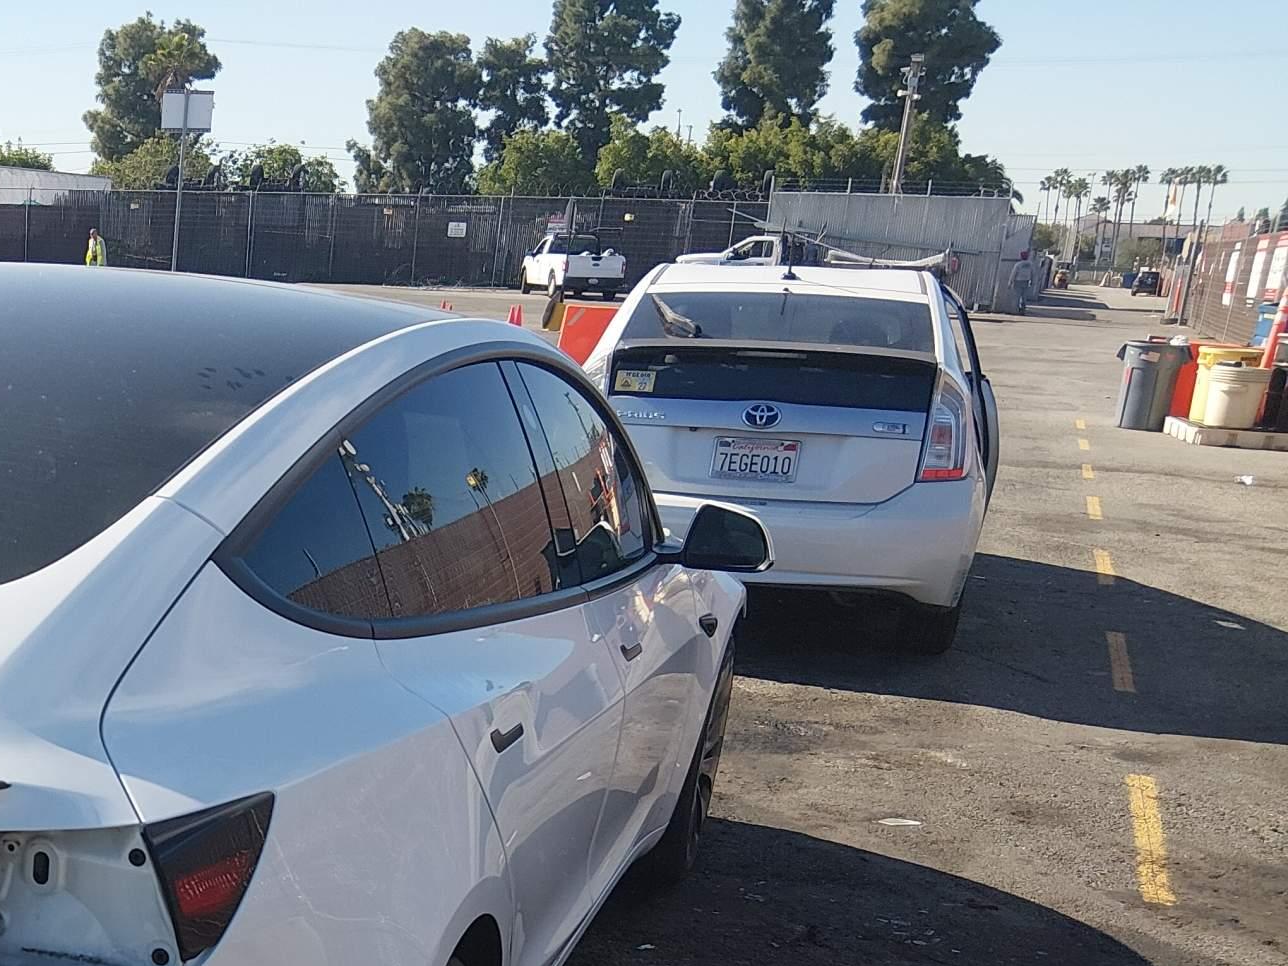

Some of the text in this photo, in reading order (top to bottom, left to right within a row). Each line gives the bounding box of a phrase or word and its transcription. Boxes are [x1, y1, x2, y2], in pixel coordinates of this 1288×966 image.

[616, 410, 665, 419] PRIUS
[732, 442, 780, 453] California
[719, 452, 792, 475] 7EGE010
